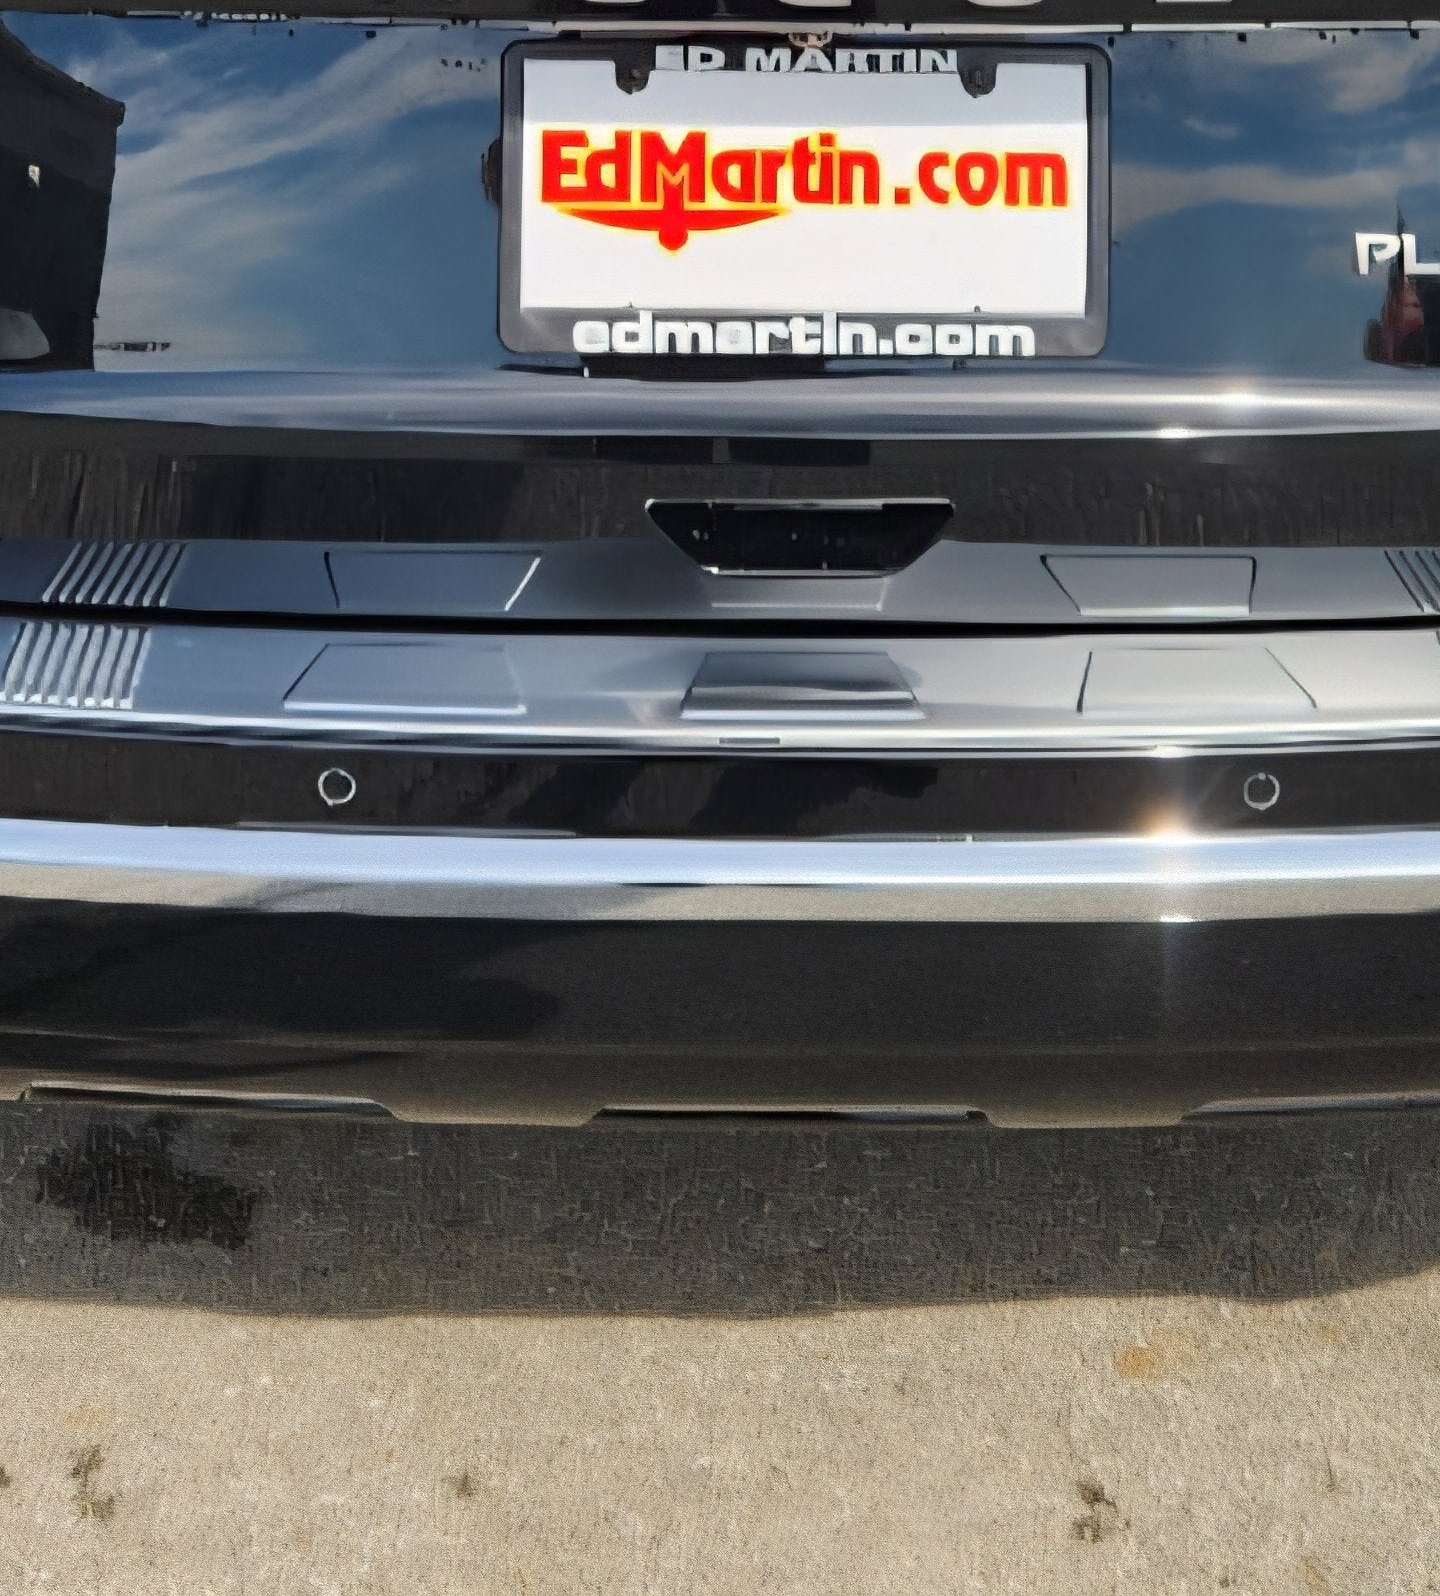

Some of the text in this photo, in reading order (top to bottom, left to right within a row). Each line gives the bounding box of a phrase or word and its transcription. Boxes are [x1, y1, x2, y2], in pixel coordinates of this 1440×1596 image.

[745, 46, 959, 73] MARTIN
[541, 129, 1069, 210] EdMartin.com
[572, 310, 1037, 357] edmartin.com
